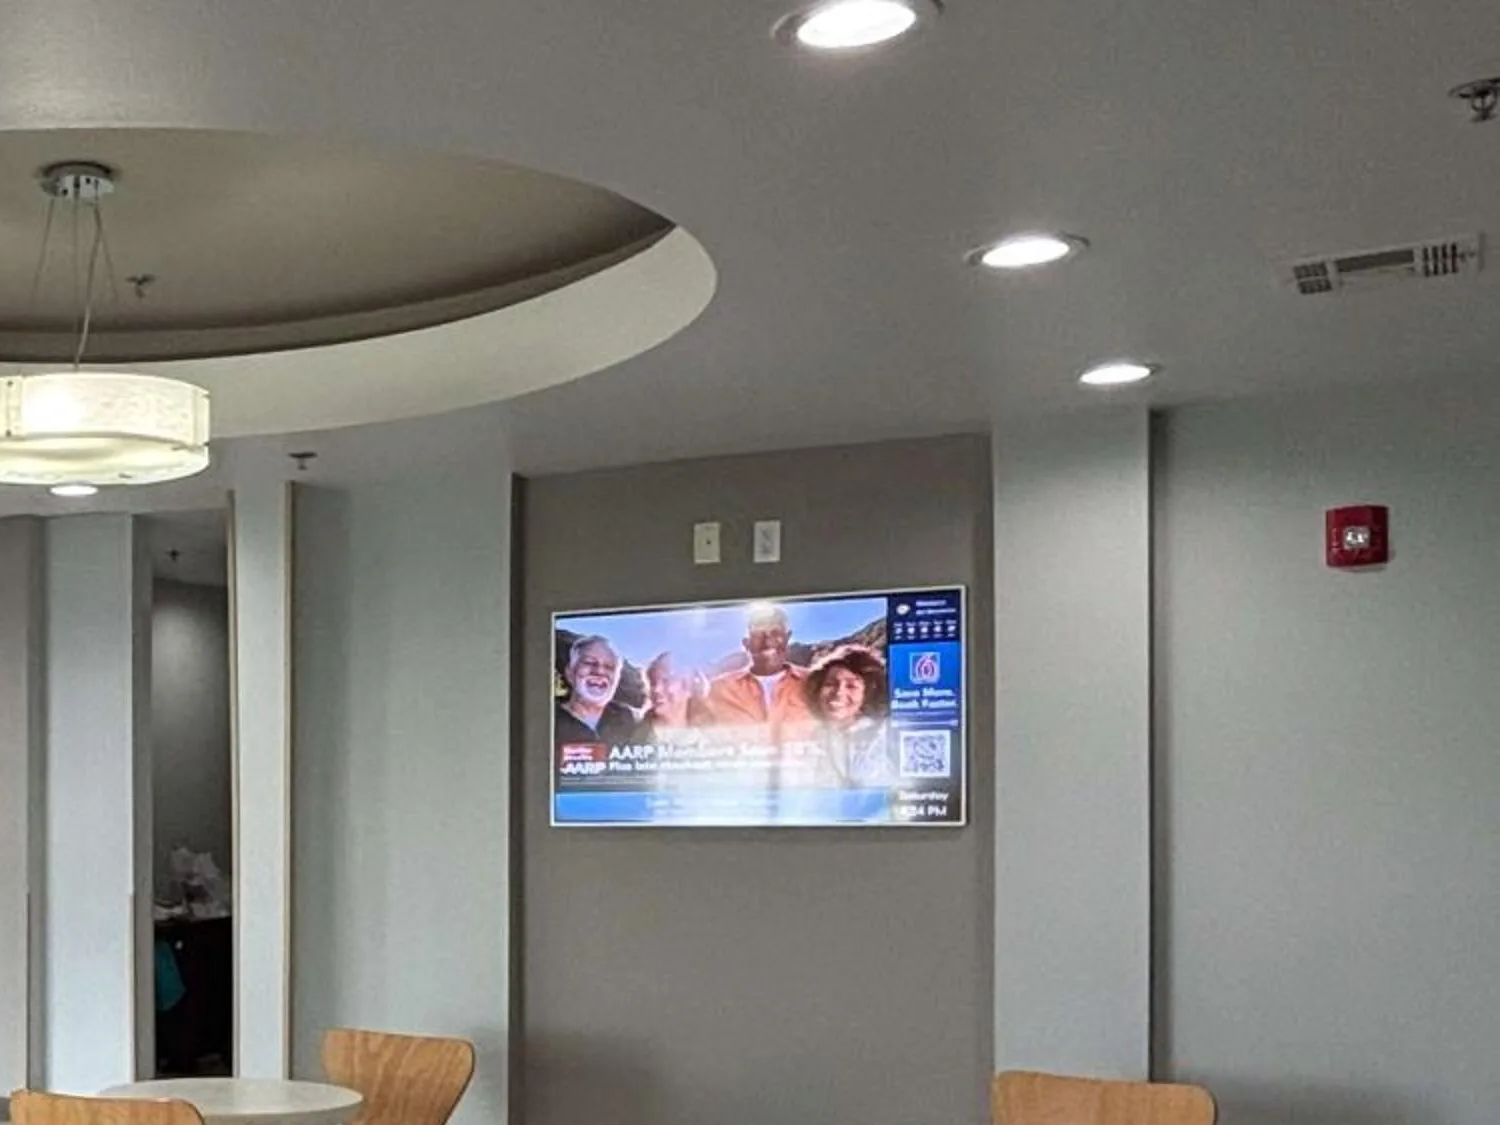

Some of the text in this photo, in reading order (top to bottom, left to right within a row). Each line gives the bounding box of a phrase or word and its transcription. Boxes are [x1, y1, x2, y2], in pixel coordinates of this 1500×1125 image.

[609, 744, 655, 760] AARP
[560, 761, 607, 775] AARP
[928, 804, 948, 817] PM
